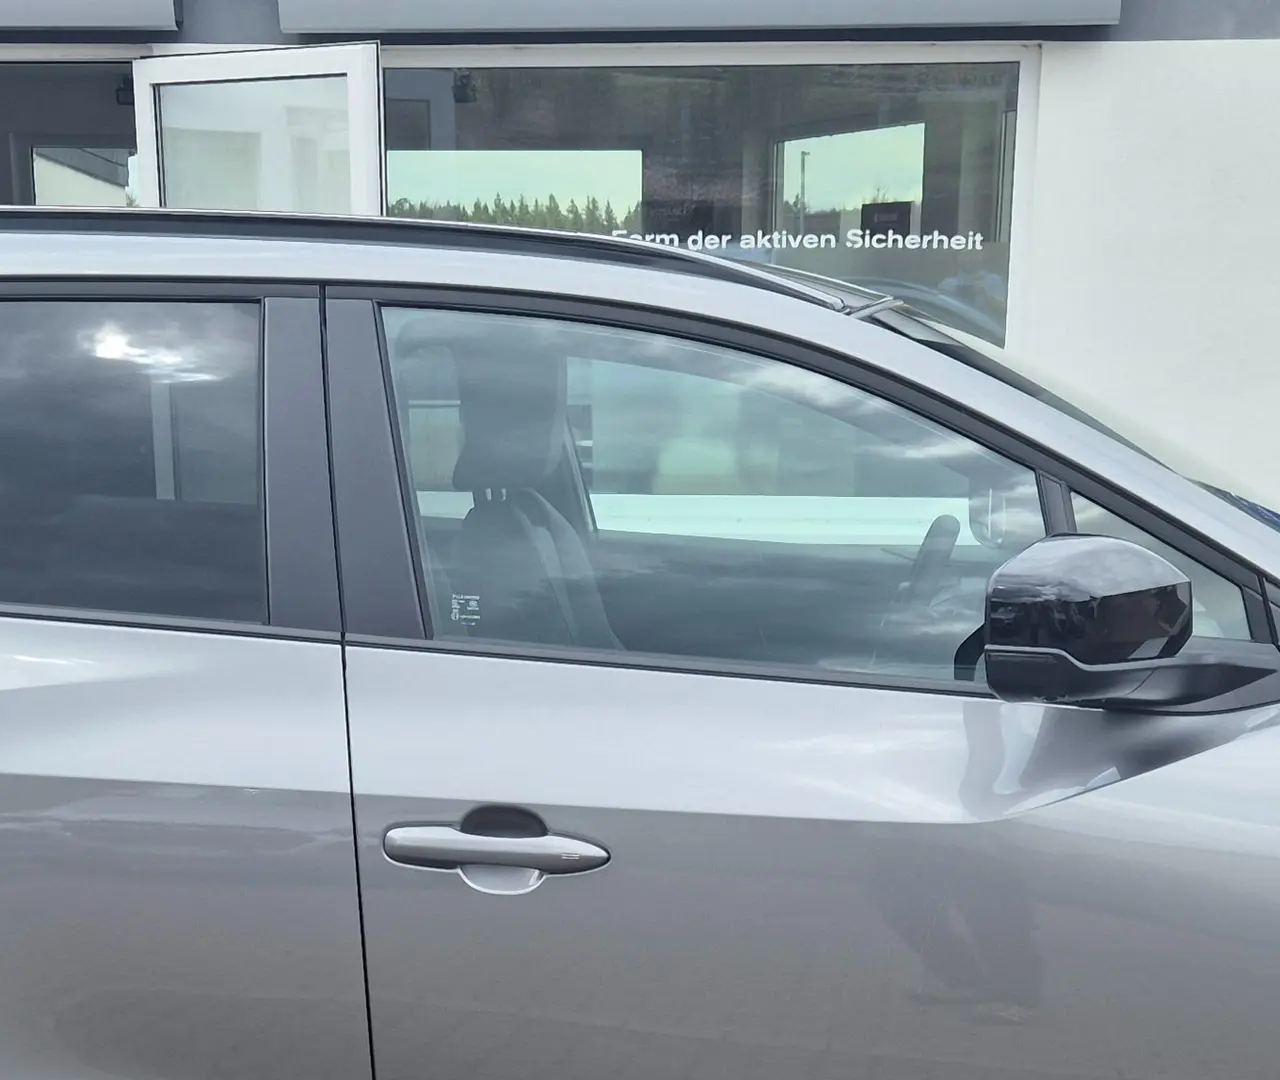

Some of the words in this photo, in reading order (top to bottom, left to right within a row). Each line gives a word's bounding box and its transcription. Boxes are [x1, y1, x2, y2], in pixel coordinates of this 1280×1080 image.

[687, 230, 732, 250] der
[739, 230, 836, 249] aktiven
[845, 229, 984, 250] Sicherheit
